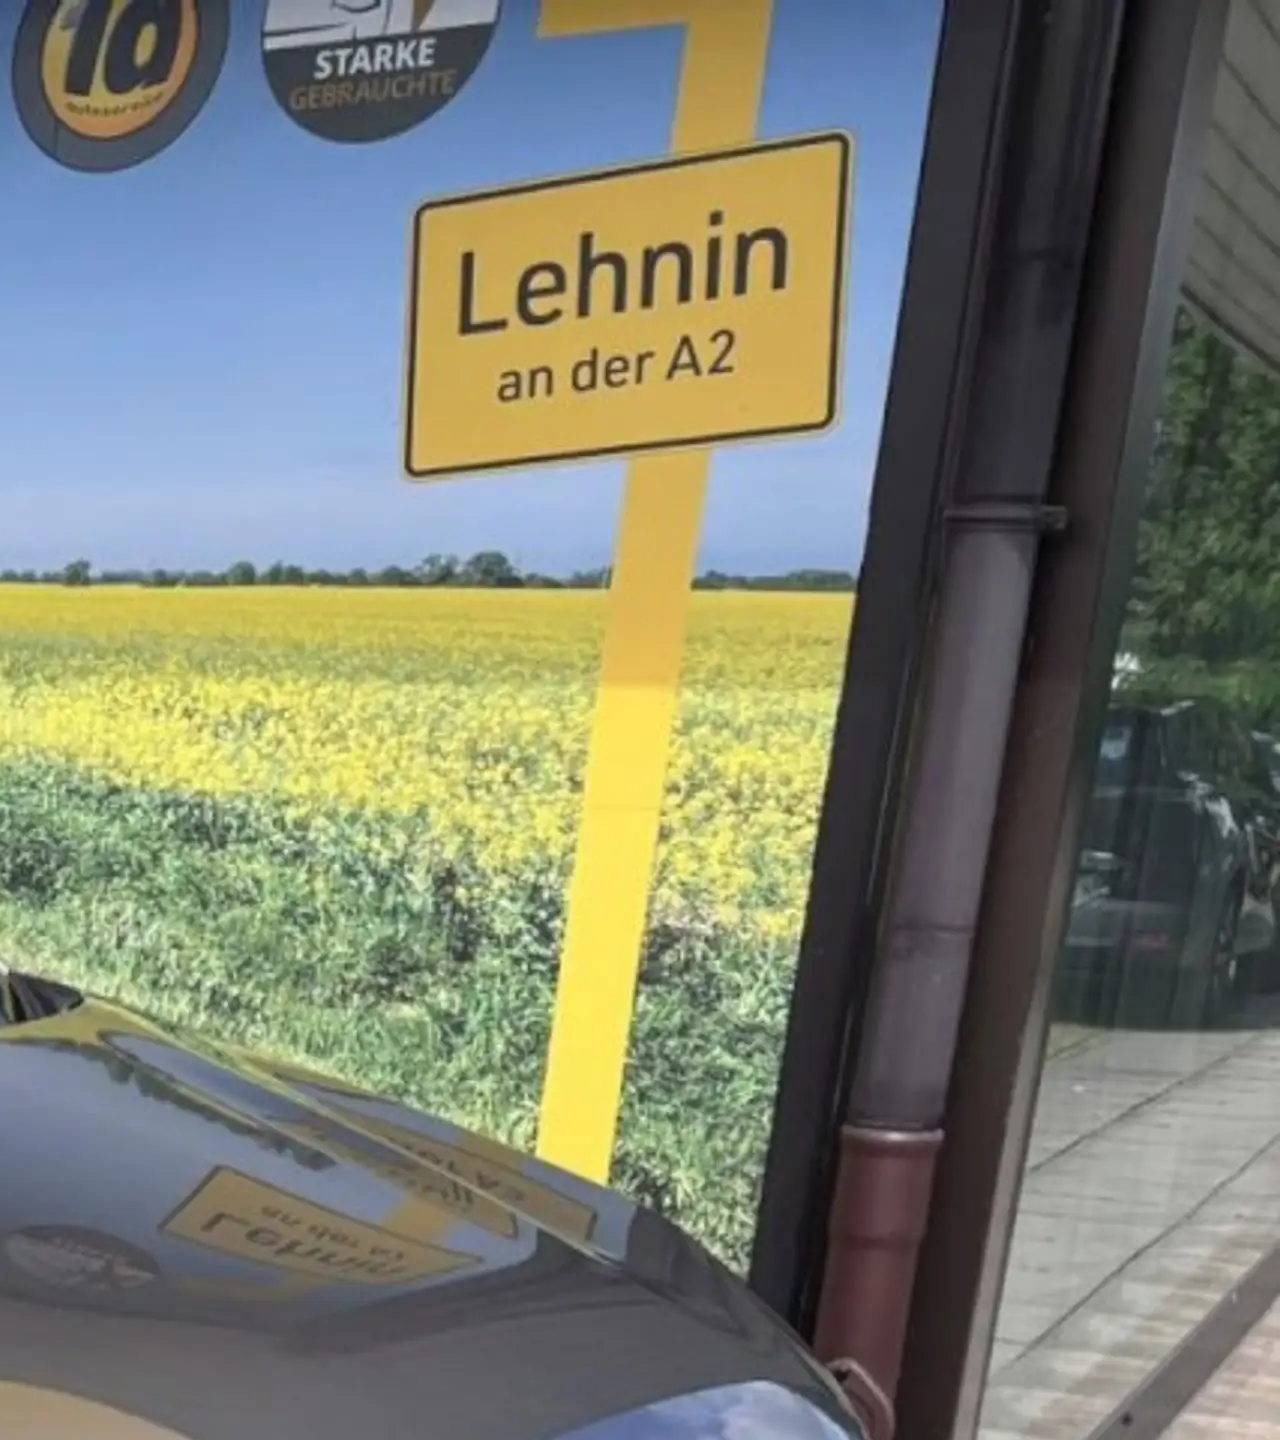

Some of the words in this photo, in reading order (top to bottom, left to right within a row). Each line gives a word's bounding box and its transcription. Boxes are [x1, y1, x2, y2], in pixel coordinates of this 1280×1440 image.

[312, 37, 437, 80] STARKE
[290, 68, 458, 110] GEBRAUCHTE
[458, 209, 789, 337] Lehnin
[495, 365, 554, 404] an
[571, 343, 655, 396] der
[665, 328, 737, 381] A2
